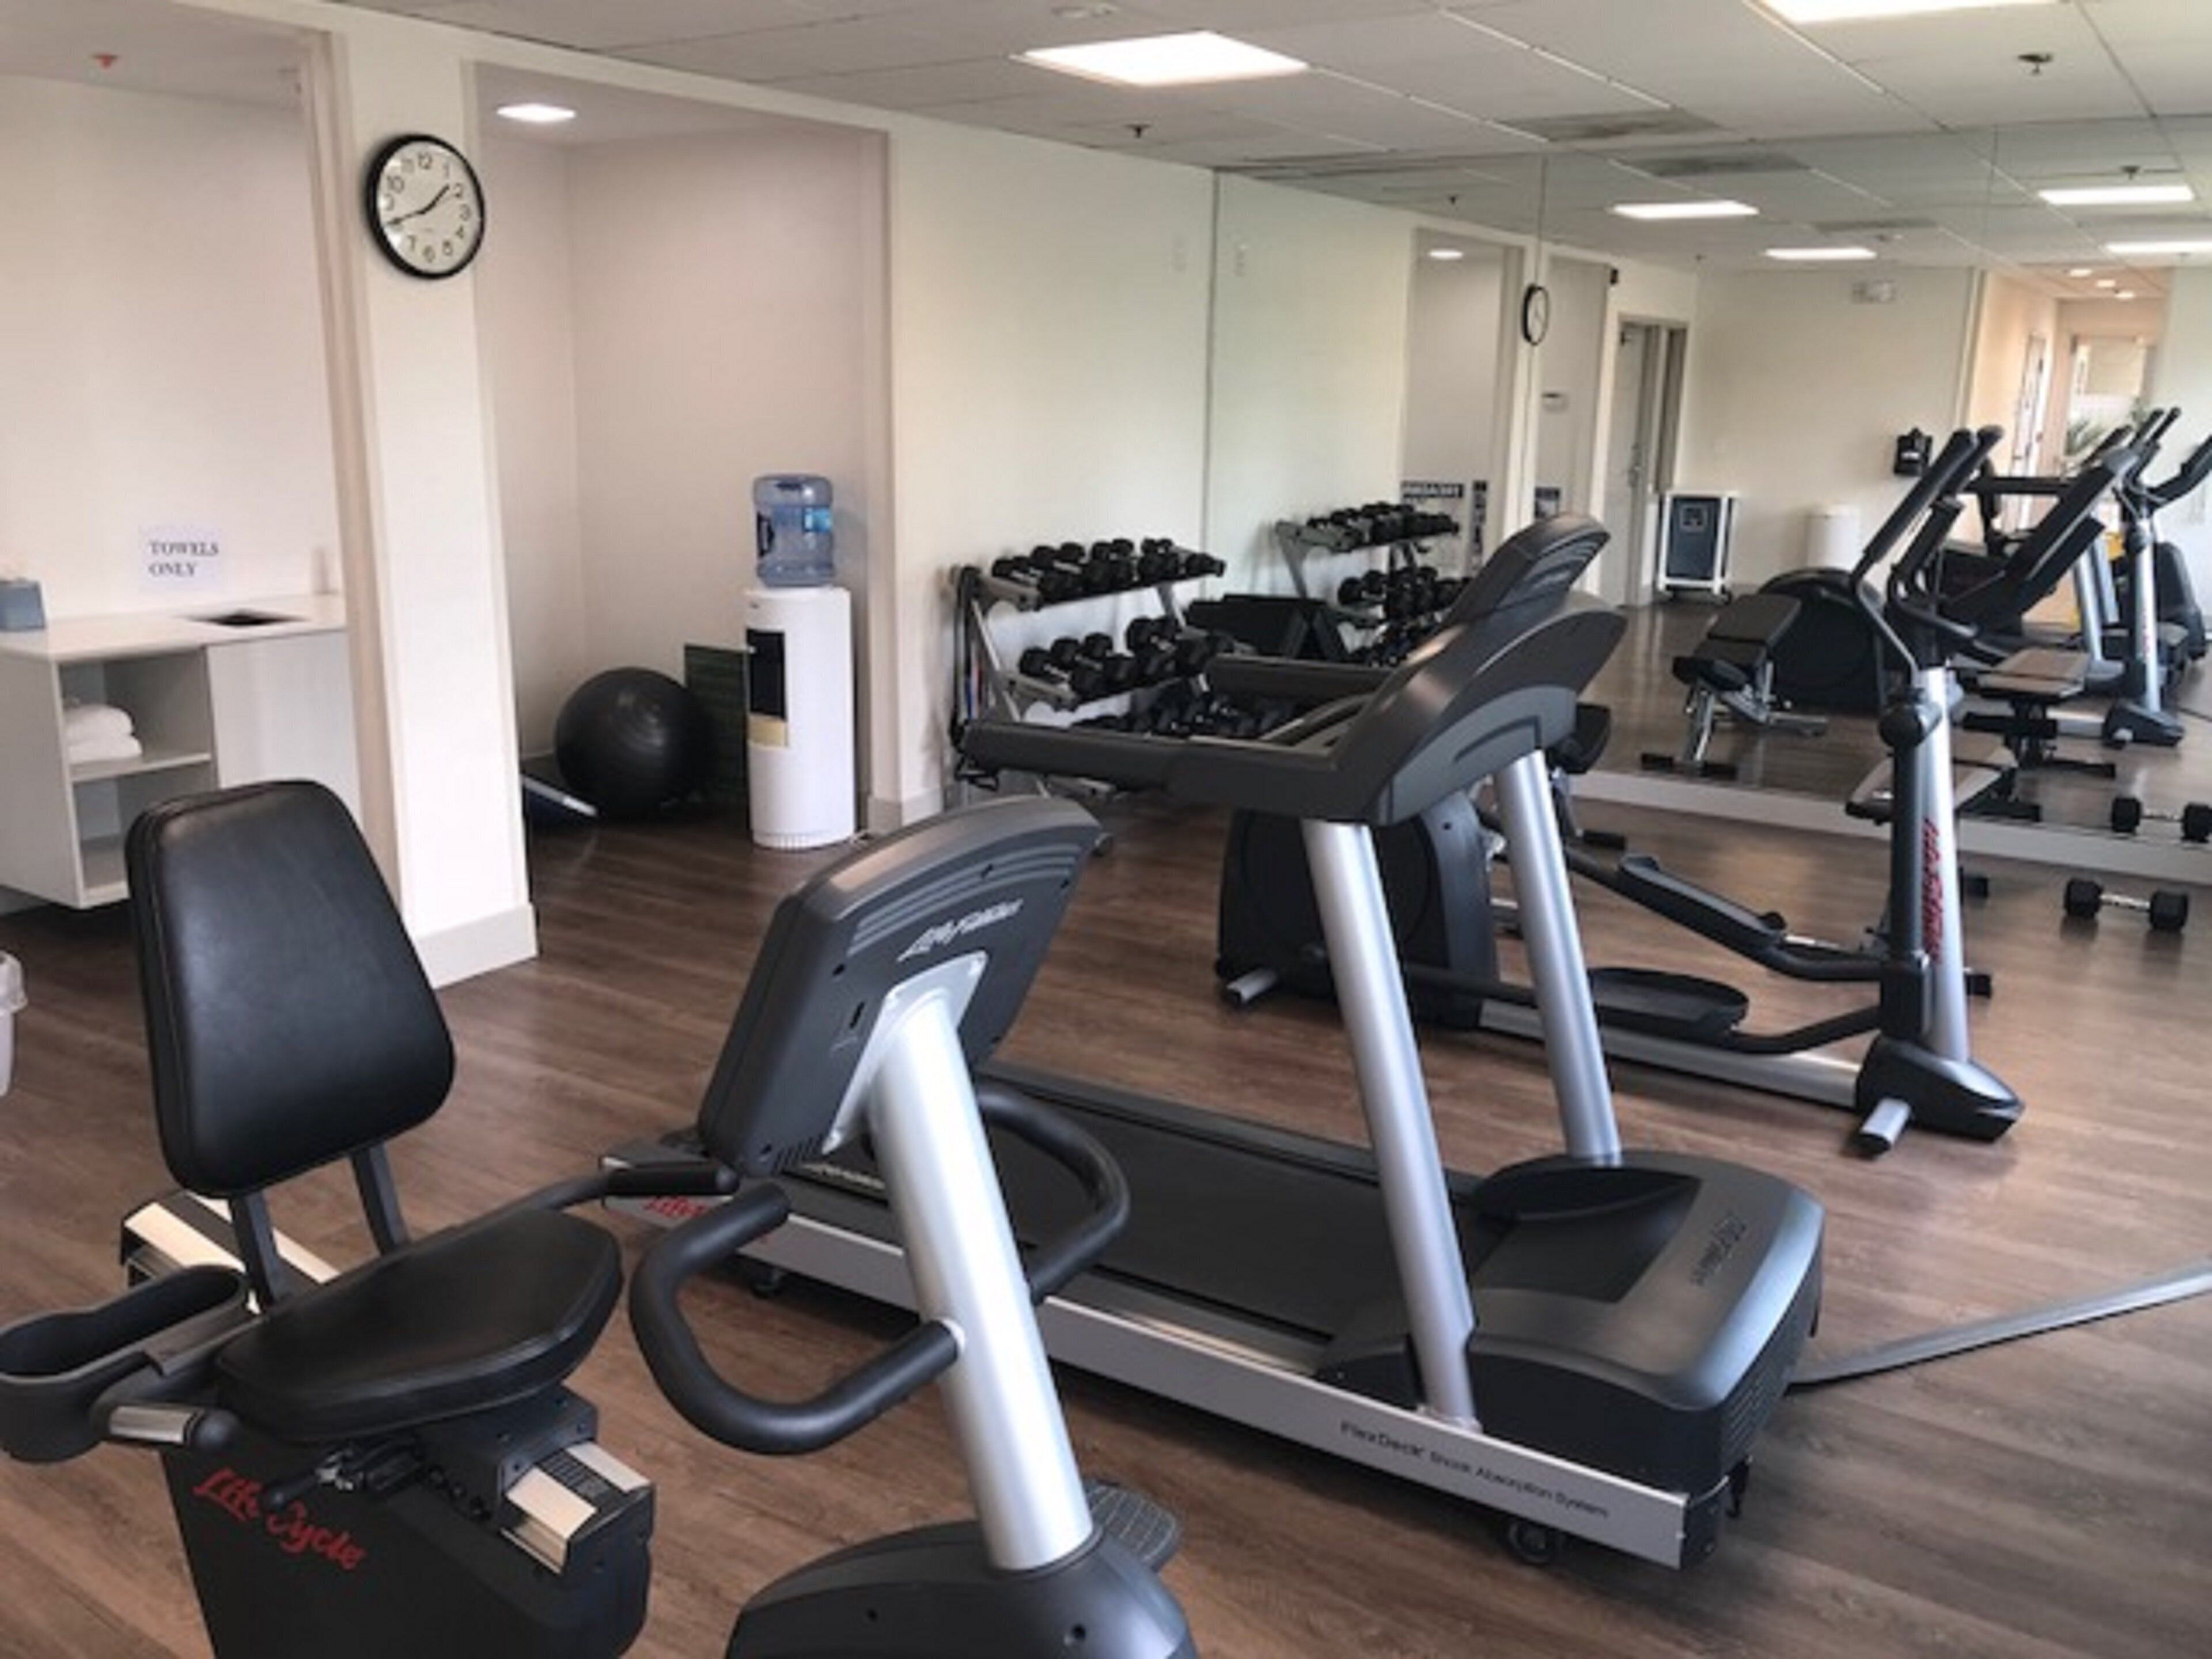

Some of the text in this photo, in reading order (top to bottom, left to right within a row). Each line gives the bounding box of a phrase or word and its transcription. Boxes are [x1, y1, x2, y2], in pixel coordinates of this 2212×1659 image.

[418, 152, 432, 170] 12
[452, 182, 464, 199] 2
[459, 203, 471, 222] 3
[406, 235, 416, 252] 7
[149, 539, 219, 556] TOWELS
[148, 562, 197, 577] ONLY
